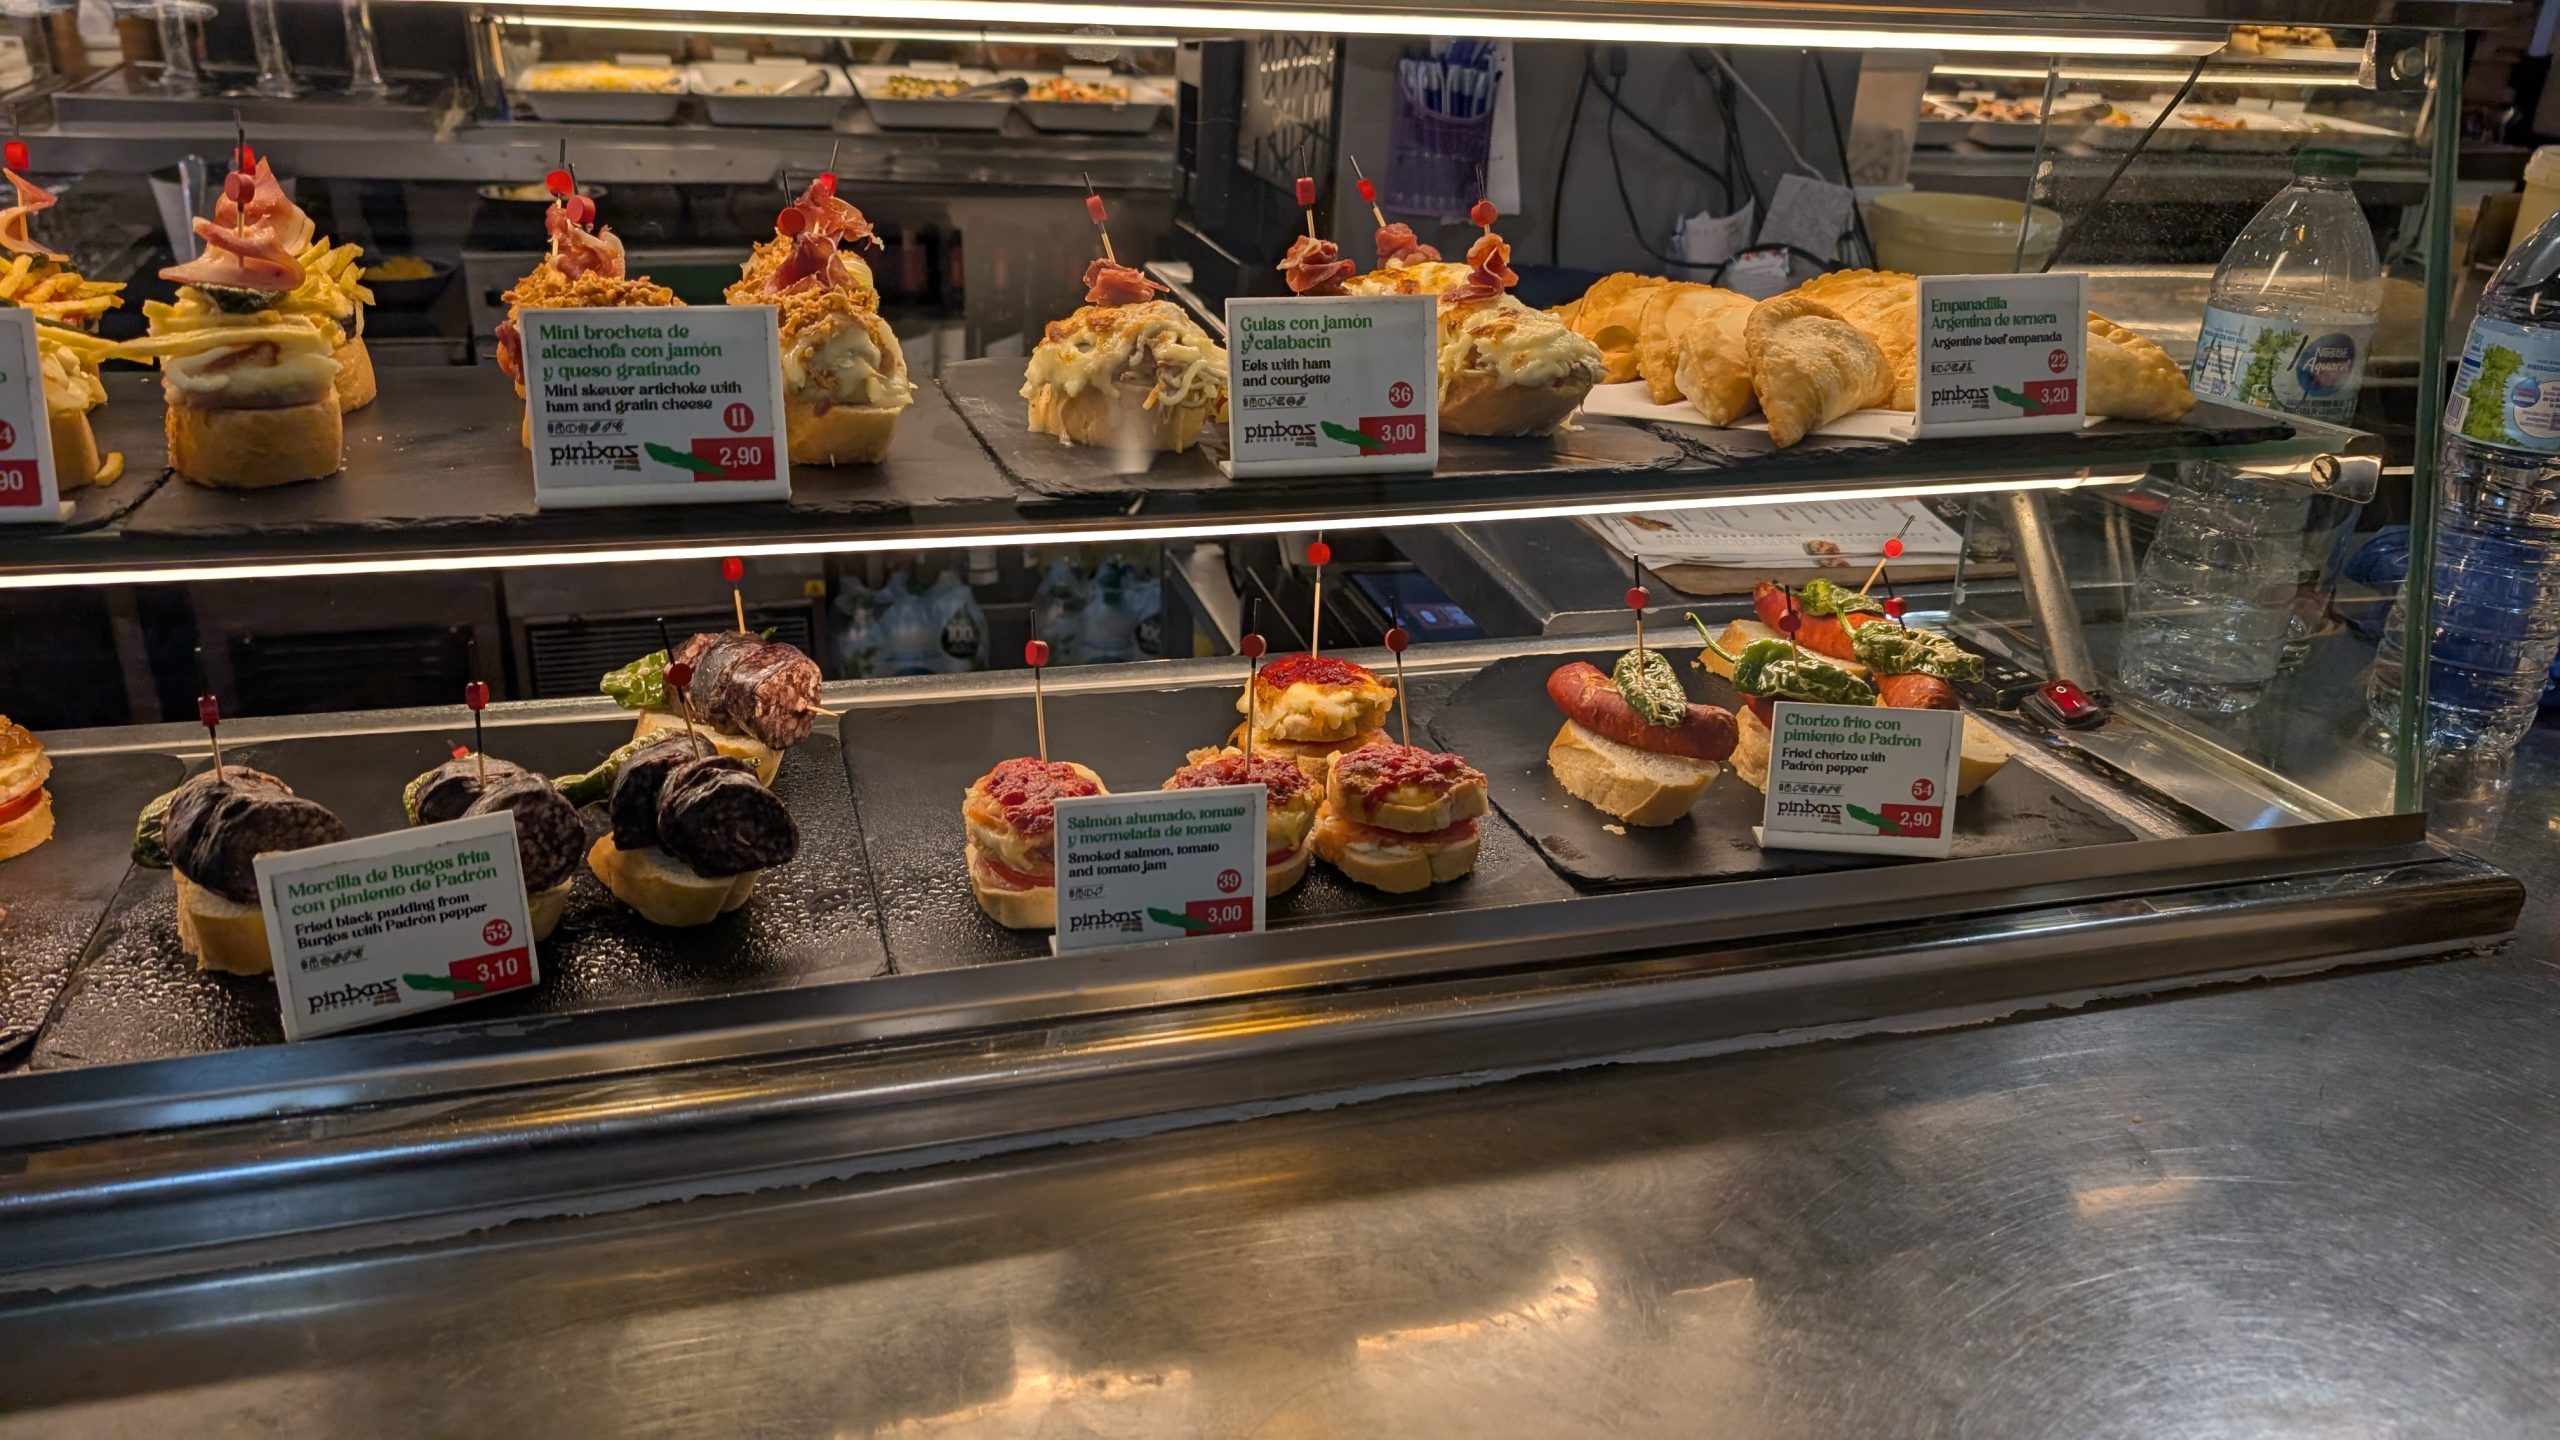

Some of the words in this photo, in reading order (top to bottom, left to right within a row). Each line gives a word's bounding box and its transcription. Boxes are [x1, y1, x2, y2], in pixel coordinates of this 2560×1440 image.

[1932, 296, 2007, 314] Empanadilla
[1241, 316, 1286, 332] Gulas
[1290, 318, 1319, 330] con
[1321, 314, 1373, 333] jamón
[1932, 314, 1992, 332] Argentina
[1995, 313, 2010, 326] de
[2013, 313, 2056, 325] ternera
[540, 325, 579, 340] Mini
[584, 324, 662, 339] brocheta
[668, 324, 689, 338] de
[1931, 336, 1982, 350] Argentine
[1984, 334, 2007, 345] beef
[2009, 332, 2062, 346] empanada
[542, 343, 626, 359] alcachofa
[631, 345, 663, 357] con
[667, 342, 722, 360] jamón
[1241, 338, 1254, 354] y
[1255, 334, 1331, 350] calabacín
[1242, 359, 1268, 372] Eels
[1272, 359, 1299, 372] with
[1303, 358, 1331, 369] ham
[2051, 354, 2066, 367] 22
[543, 366, 553, 382] y
[559, 366, 611, 381] queso
[617, 362, 700, 380] gratinado
[1242, 374, 1267, 387] and
[1271, 373, 1331, 387] courgette
[544, 384, 578, 397] Mini
[582, 384, 635, 396] skewer
[639, 382, 707, 395] artichoke
[711, 382, 742, 394] with
[1391, 386, 1411, 403] 36
[2041, 387, 2069, 406] 3,20
[546, 401, 579, 413] ham
[583, 400, 611, 412] and
[615, 398, 658, 414] gratin
[662, 398, 712, 411] cheese
[731, 407, 746, 427] 11
[1382, 423, 1416, 444] 3,00
[720, 446, 761, 469] 2,90
[1785, 713, 1840, 728] Chorizo
[1843, 716, 1872, 729] frito
[1875, 719, 1901, 731] con
[1783, 729, 1845, 745] pimiento
[1848, 732, 1866, 744] de
[1869, 733, 1921, 747] Padrón
[1782, 748, 1812, 759] Fried
[1815, 749, 1857, 761] chorizo
[1861, 752, 1886, 763] with
[1781, 760, 1823, 772] Padrón
[1826, 763, 1868, 775] pepper
[1913, 782, 1933, 797] 54
[1068, 814, 1122, 830] Salmón
[1126, 808, 1196, 825] ahumado,
[1200, 805, 1246, 819] tomate
[1900, 811, 1932, 828] 2,90
[1068, 835, 1076, 849] y
[1080, 827, 1160, 844] mermelada
[1165, 825, 1182, 837] de
[1186, 822, 1232, 836] tomate
[1068, 848, 1121, 864] Smoked
[1124, 846, 1174, 859] salmon,
[1177, 843, 1219, 855] tomato
[288, 874, 361, 899] Morcilla
[366, 864, 387, 883] de
[392, 856, 453, 880] Burgos
[457, 850, 491, 866] frita
[1069, 866, 1093, 878] and
[1097, 863, 1140, 875] tomato
[1141, 860, 1167, 874] jam
[1219, 873, 1239, 888] 39
[292, 899, 326, 916] con
[330, 884, 406, 912] pimiento
[410, 877, 431, 893] de
[435, 866, 497, 890] Padrón
[295, 919, 333, 937] Fried
[336, 910, 373, 927] black
[377, 899, 435, 922] pudding
[438, 892, 470, 908] from
[1208, 905, 1242, 924] 3,00
[298, 930, 348, 950] Burgos
[352, 923, 383, 939] with
[386, 913, 436, 932] Padrón
[439, 903, 487, 923] pepper
[485, 923, 509, 942] 53
[477, 957, 519, 982] 3,10
